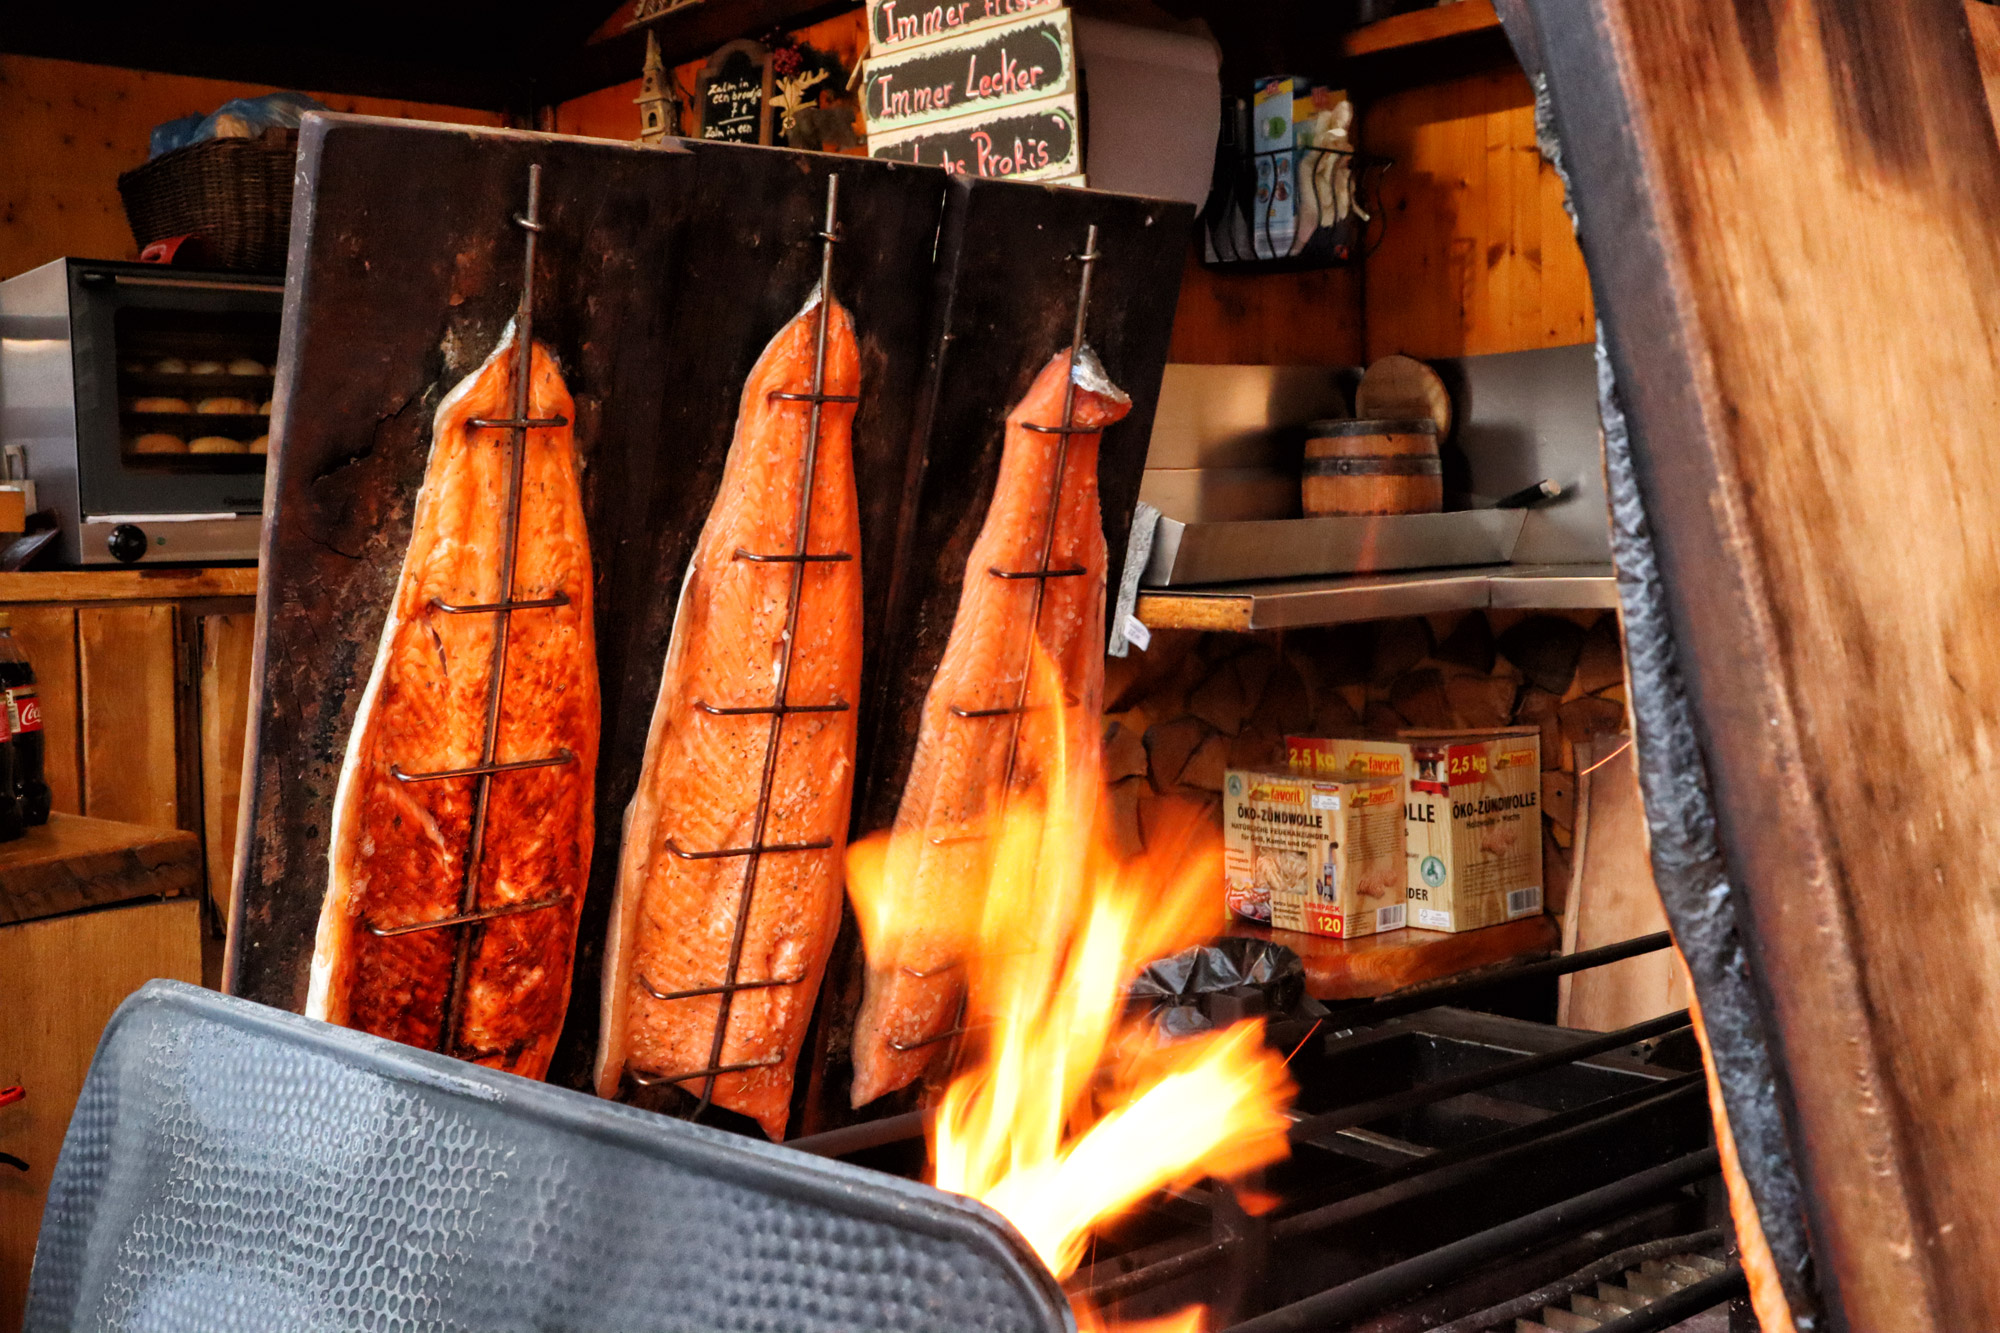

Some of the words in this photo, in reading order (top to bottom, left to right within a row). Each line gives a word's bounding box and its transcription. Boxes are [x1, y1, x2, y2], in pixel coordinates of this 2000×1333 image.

[883, 0, 969, 43] Immer
[739, 77, 749, 88] in
[878, 74, 954, 116] Immer
[965, 48, 1043, 96] Lecker
[726, 124, 736, 136] in
[970, 131, 1049, 177] Profis
[1369, 755, 1399, 772] favorit
[1451, 756, 1469, 775] 2,5
[1472, 754, 1487, 774] kg
[1271, 788, 1301, 803] favorit
[1453, 792, 1536, 819] ÖKO-ZÜNDWOLLE
[1237, 803, 1323, 829] ÖKO-ZÜNDWOLLE
[1318, 916, 1341, 933] 120
